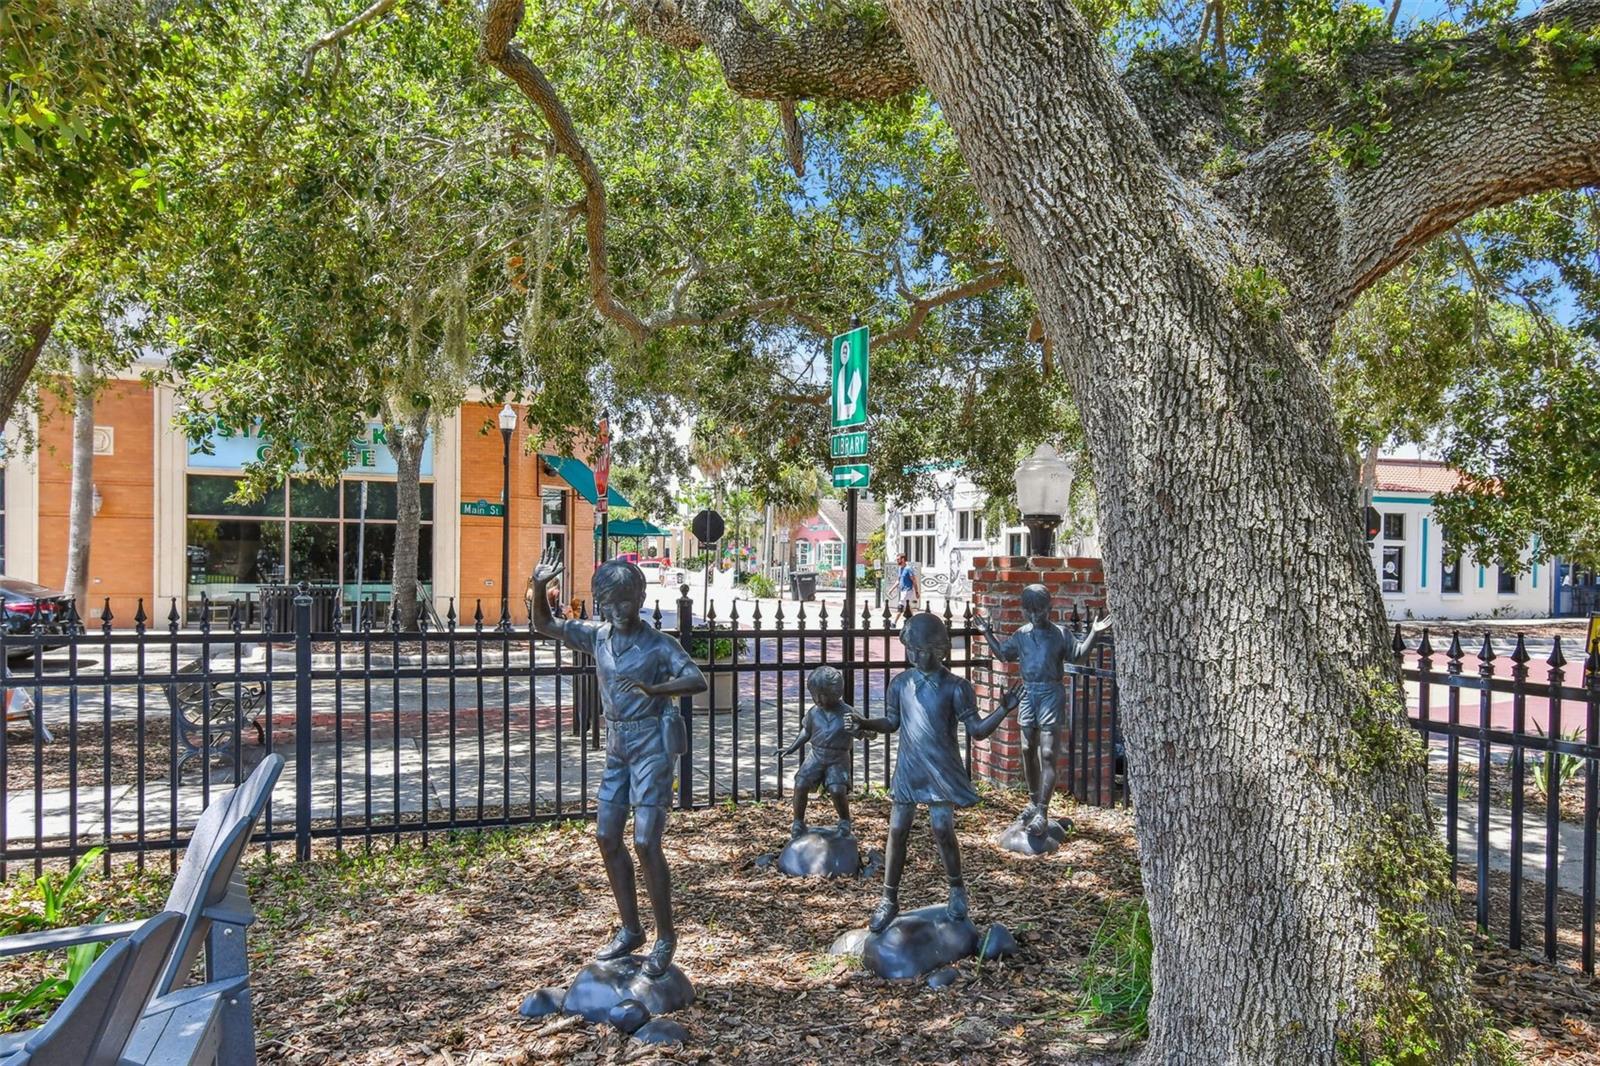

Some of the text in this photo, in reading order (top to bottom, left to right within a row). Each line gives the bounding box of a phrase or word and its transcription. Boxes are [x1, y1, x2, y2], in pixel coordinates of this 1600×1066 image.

[833, 435, 866, 455] LIBRARY
[464, 503, 485, 515] Main
[489, 505, 500, 516] St
